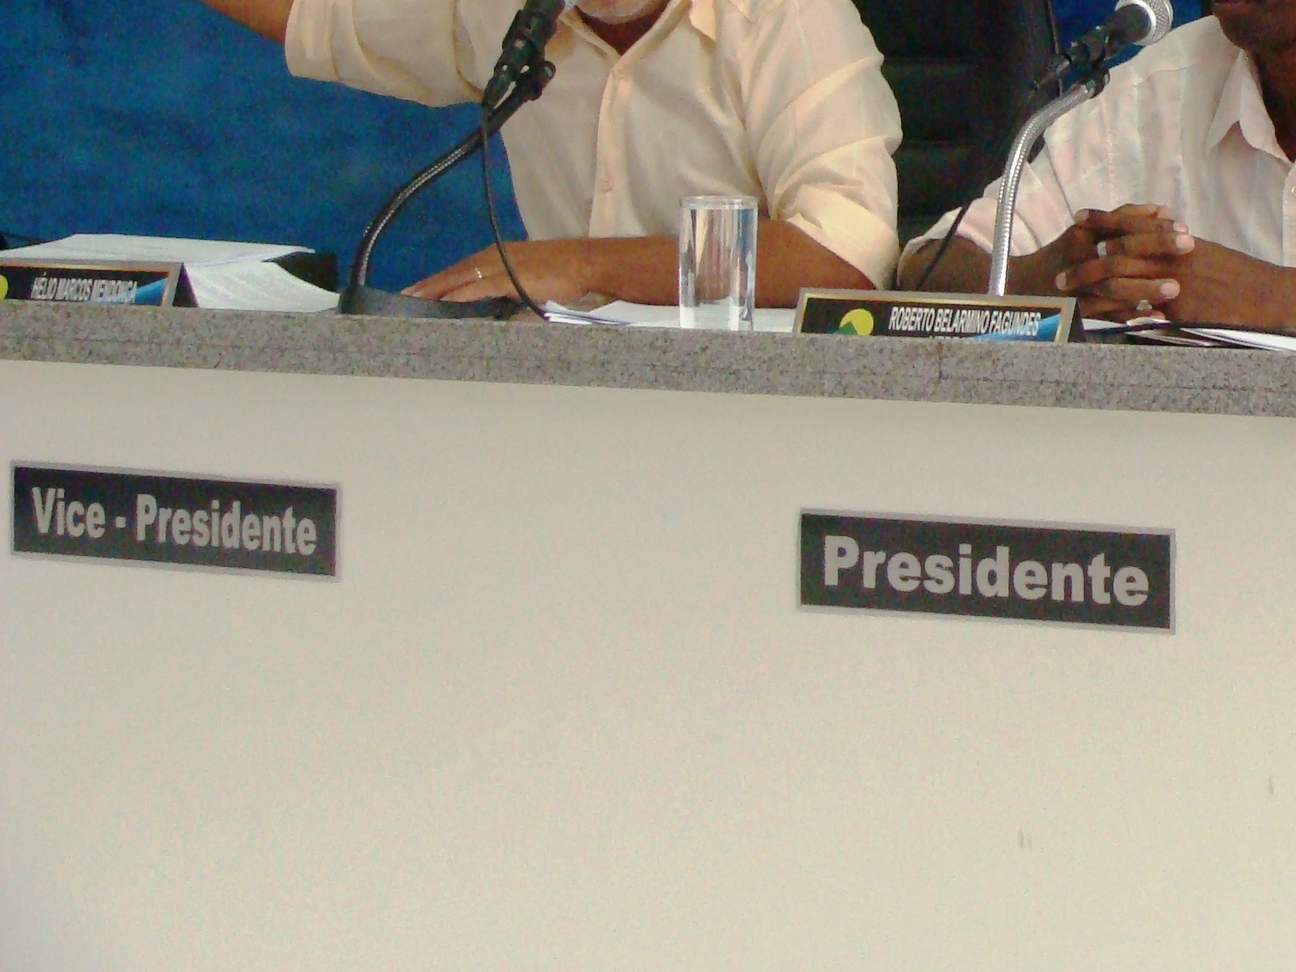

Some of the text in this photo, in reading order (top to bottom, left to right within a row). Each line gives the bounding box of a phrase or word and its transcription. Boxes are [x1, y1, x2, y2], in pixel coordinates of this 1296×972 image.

[888, 306, 1041, 336] ROBERTO BELARMINO FAGUNDES
[31, 486, 106, 538] Vice
[136, 493, 318, 556] Presidente
[824, 534, 1150, 607] Presidente
